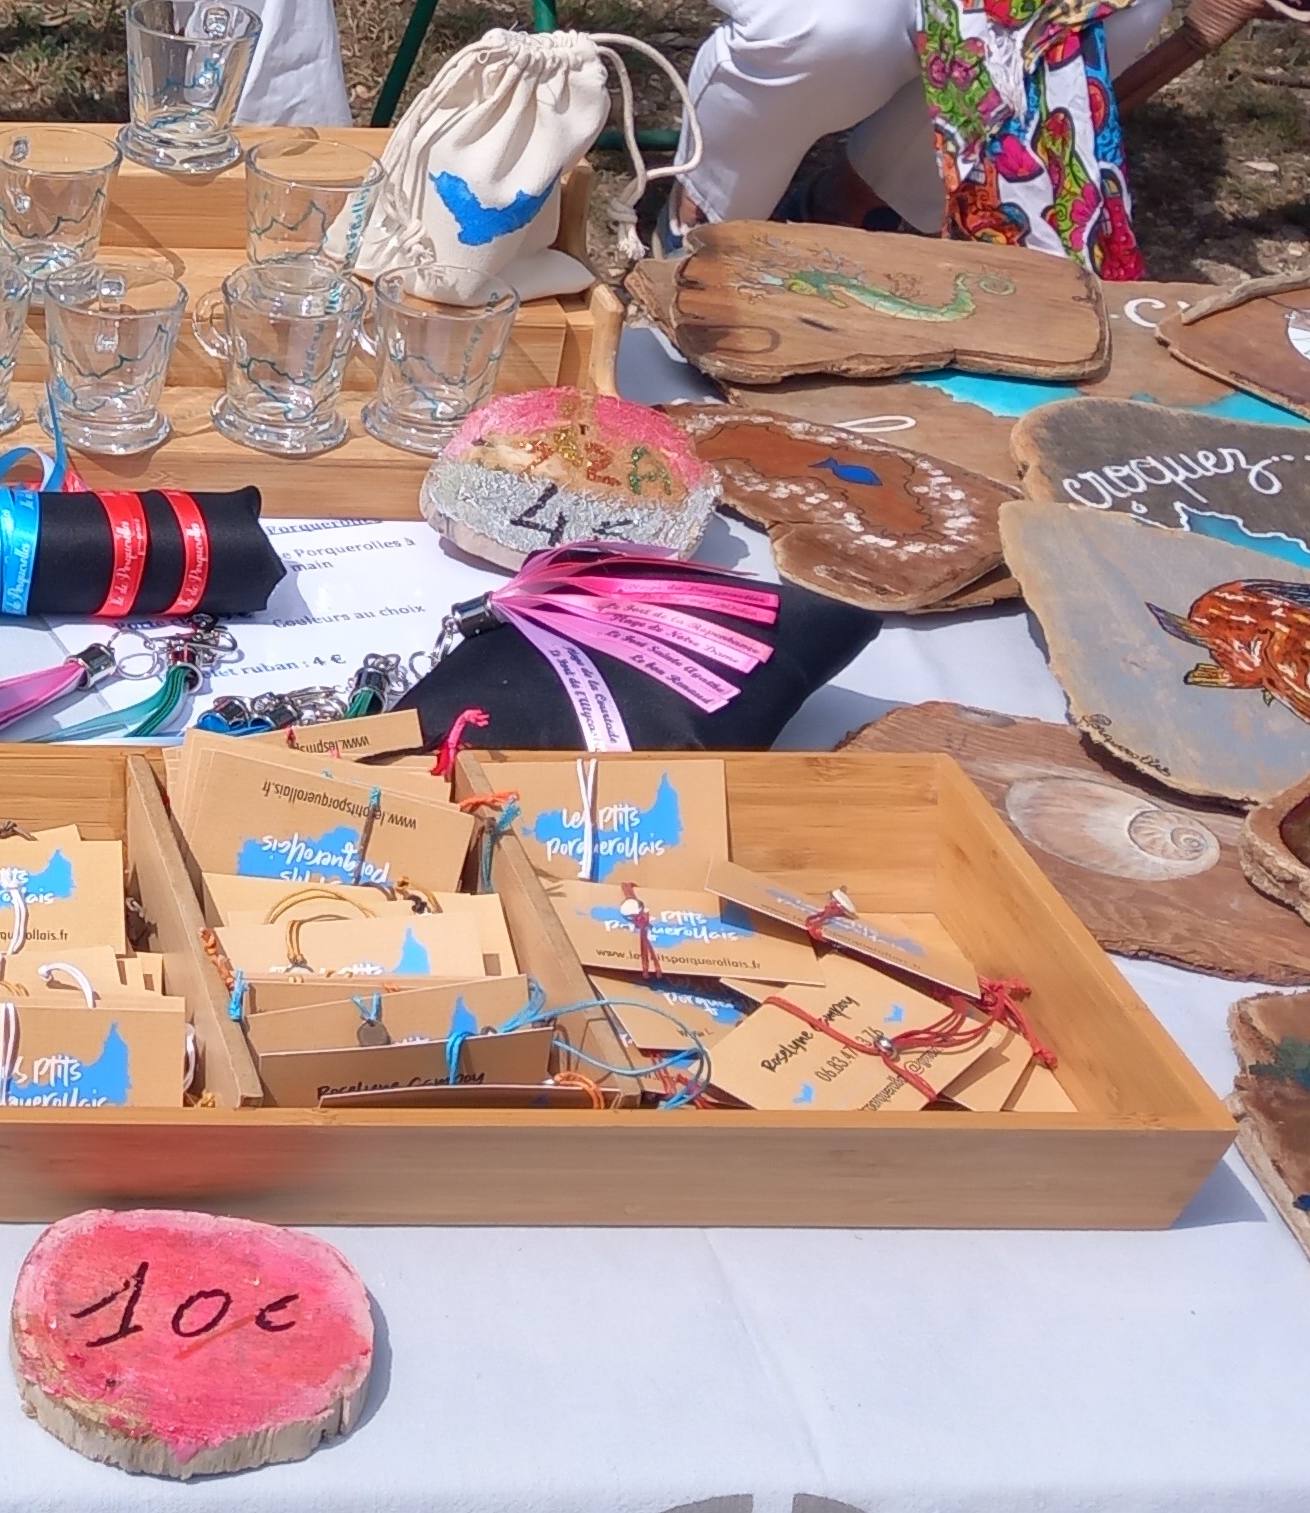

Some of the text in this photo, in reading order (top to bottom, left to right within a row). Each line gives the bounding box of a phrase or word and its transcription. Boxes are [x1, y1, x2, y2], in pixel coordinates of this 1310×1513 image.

[293, 540, 403, 557] Porquerolles
[290, 560, 334, 572] main
[272, 605, 426, 629] Couleurs au choix
[241, 653, 347, 676] ruban 4 €
[261, 779, 418, 830] www.leptitsporquerollais.fr
